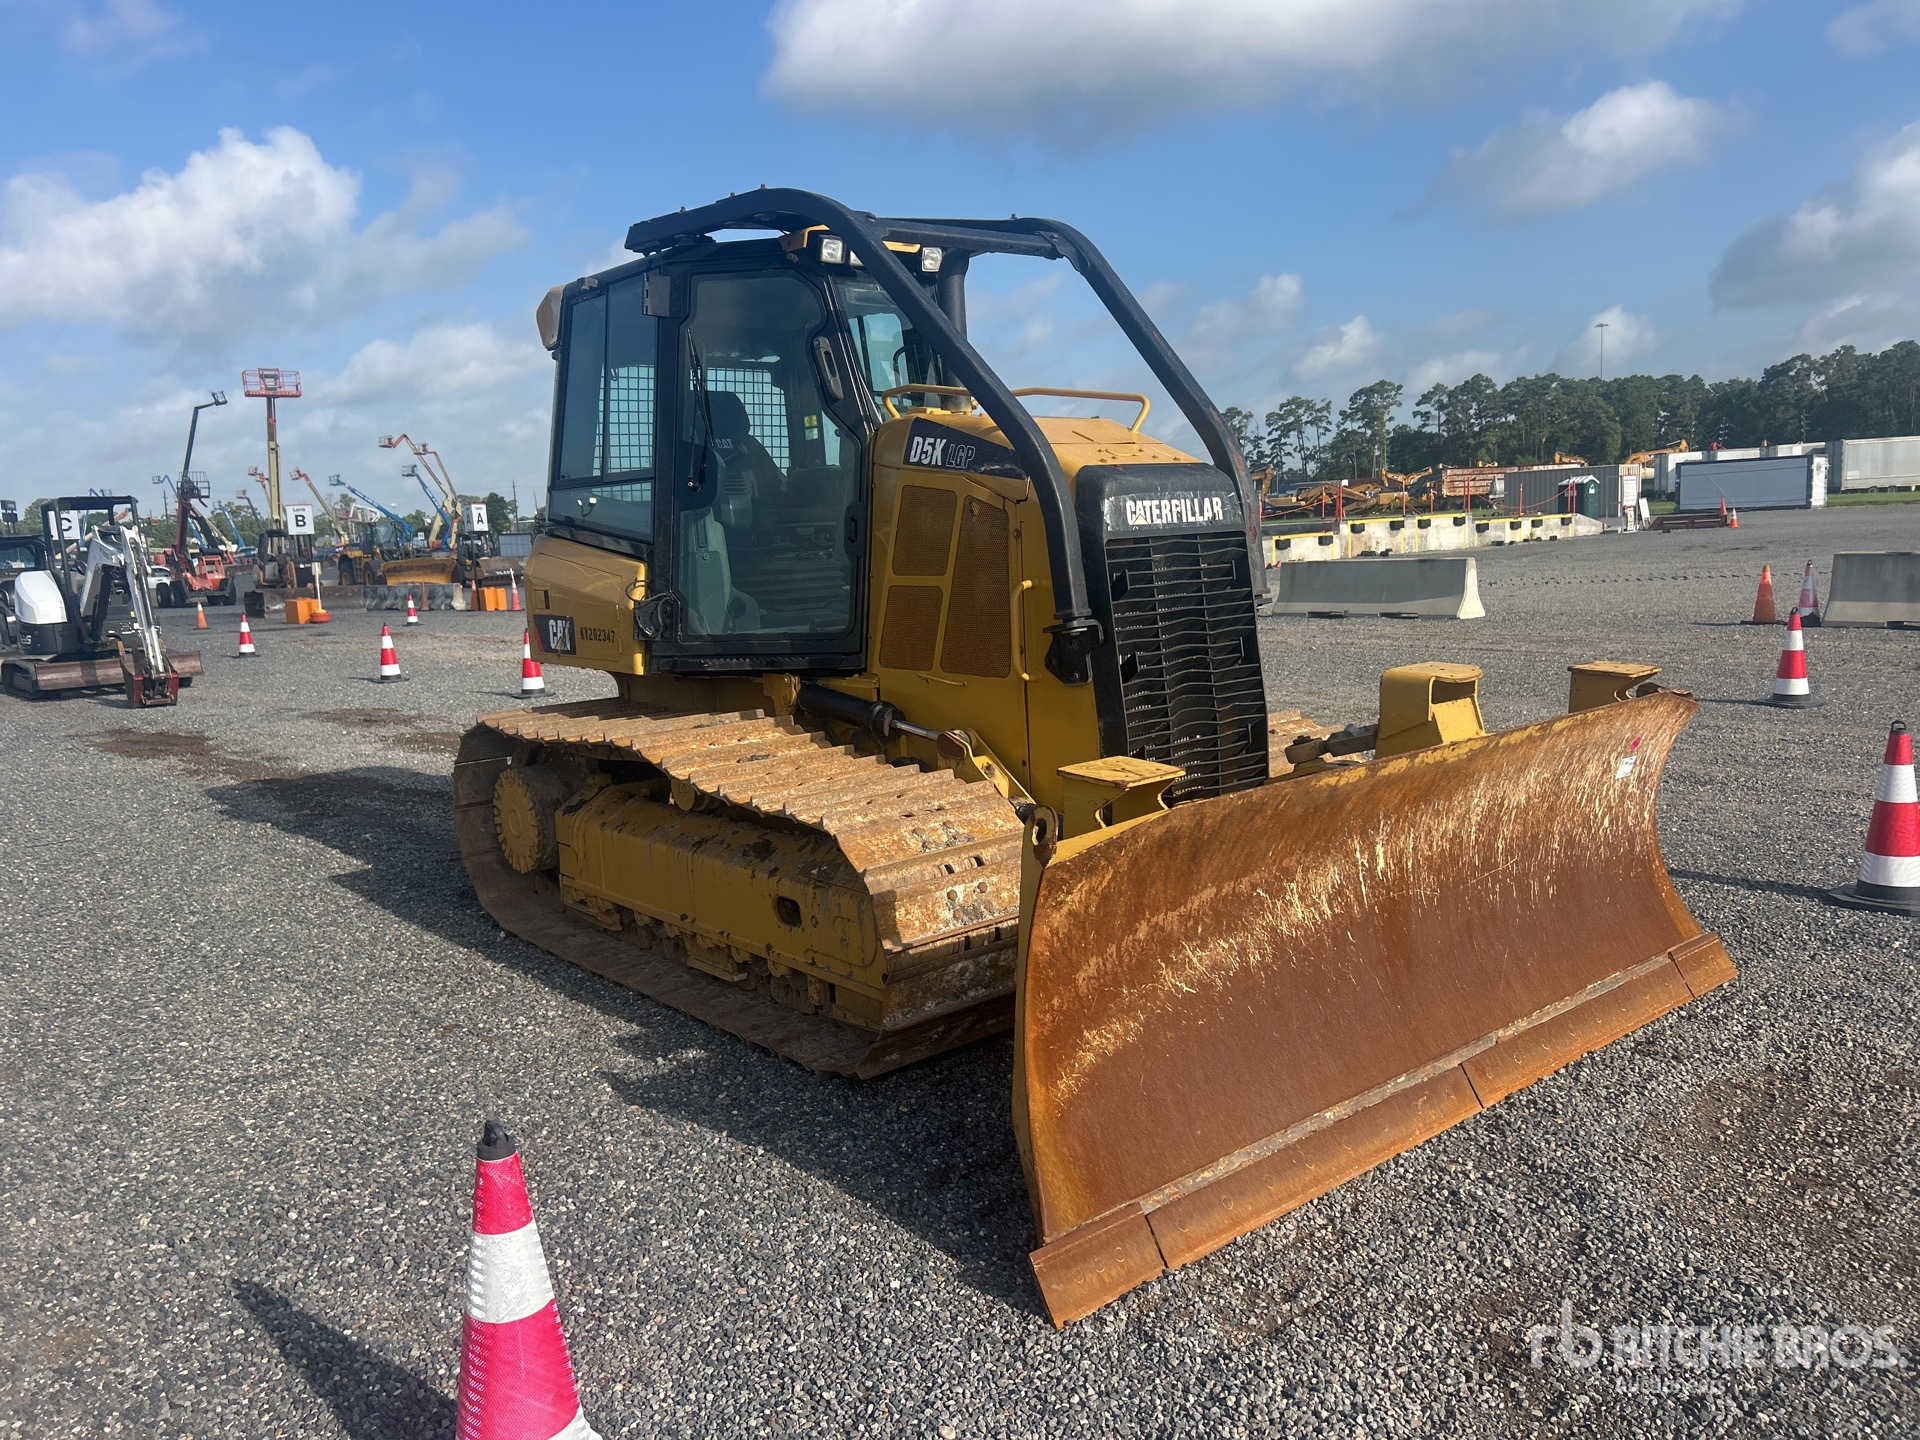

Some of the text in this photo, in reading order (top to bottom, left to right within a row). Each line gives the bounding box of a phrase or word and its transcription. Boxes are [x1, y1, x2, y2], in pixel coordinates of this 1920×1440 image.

[715, 438, 734, 449] CAT
[909, 436, 976, 469] D5K LGP
[1126, 497, 1223, 526] CATERPILLAR
[295, 514, 306, 527] B
[477, 512, 485, 525] A
